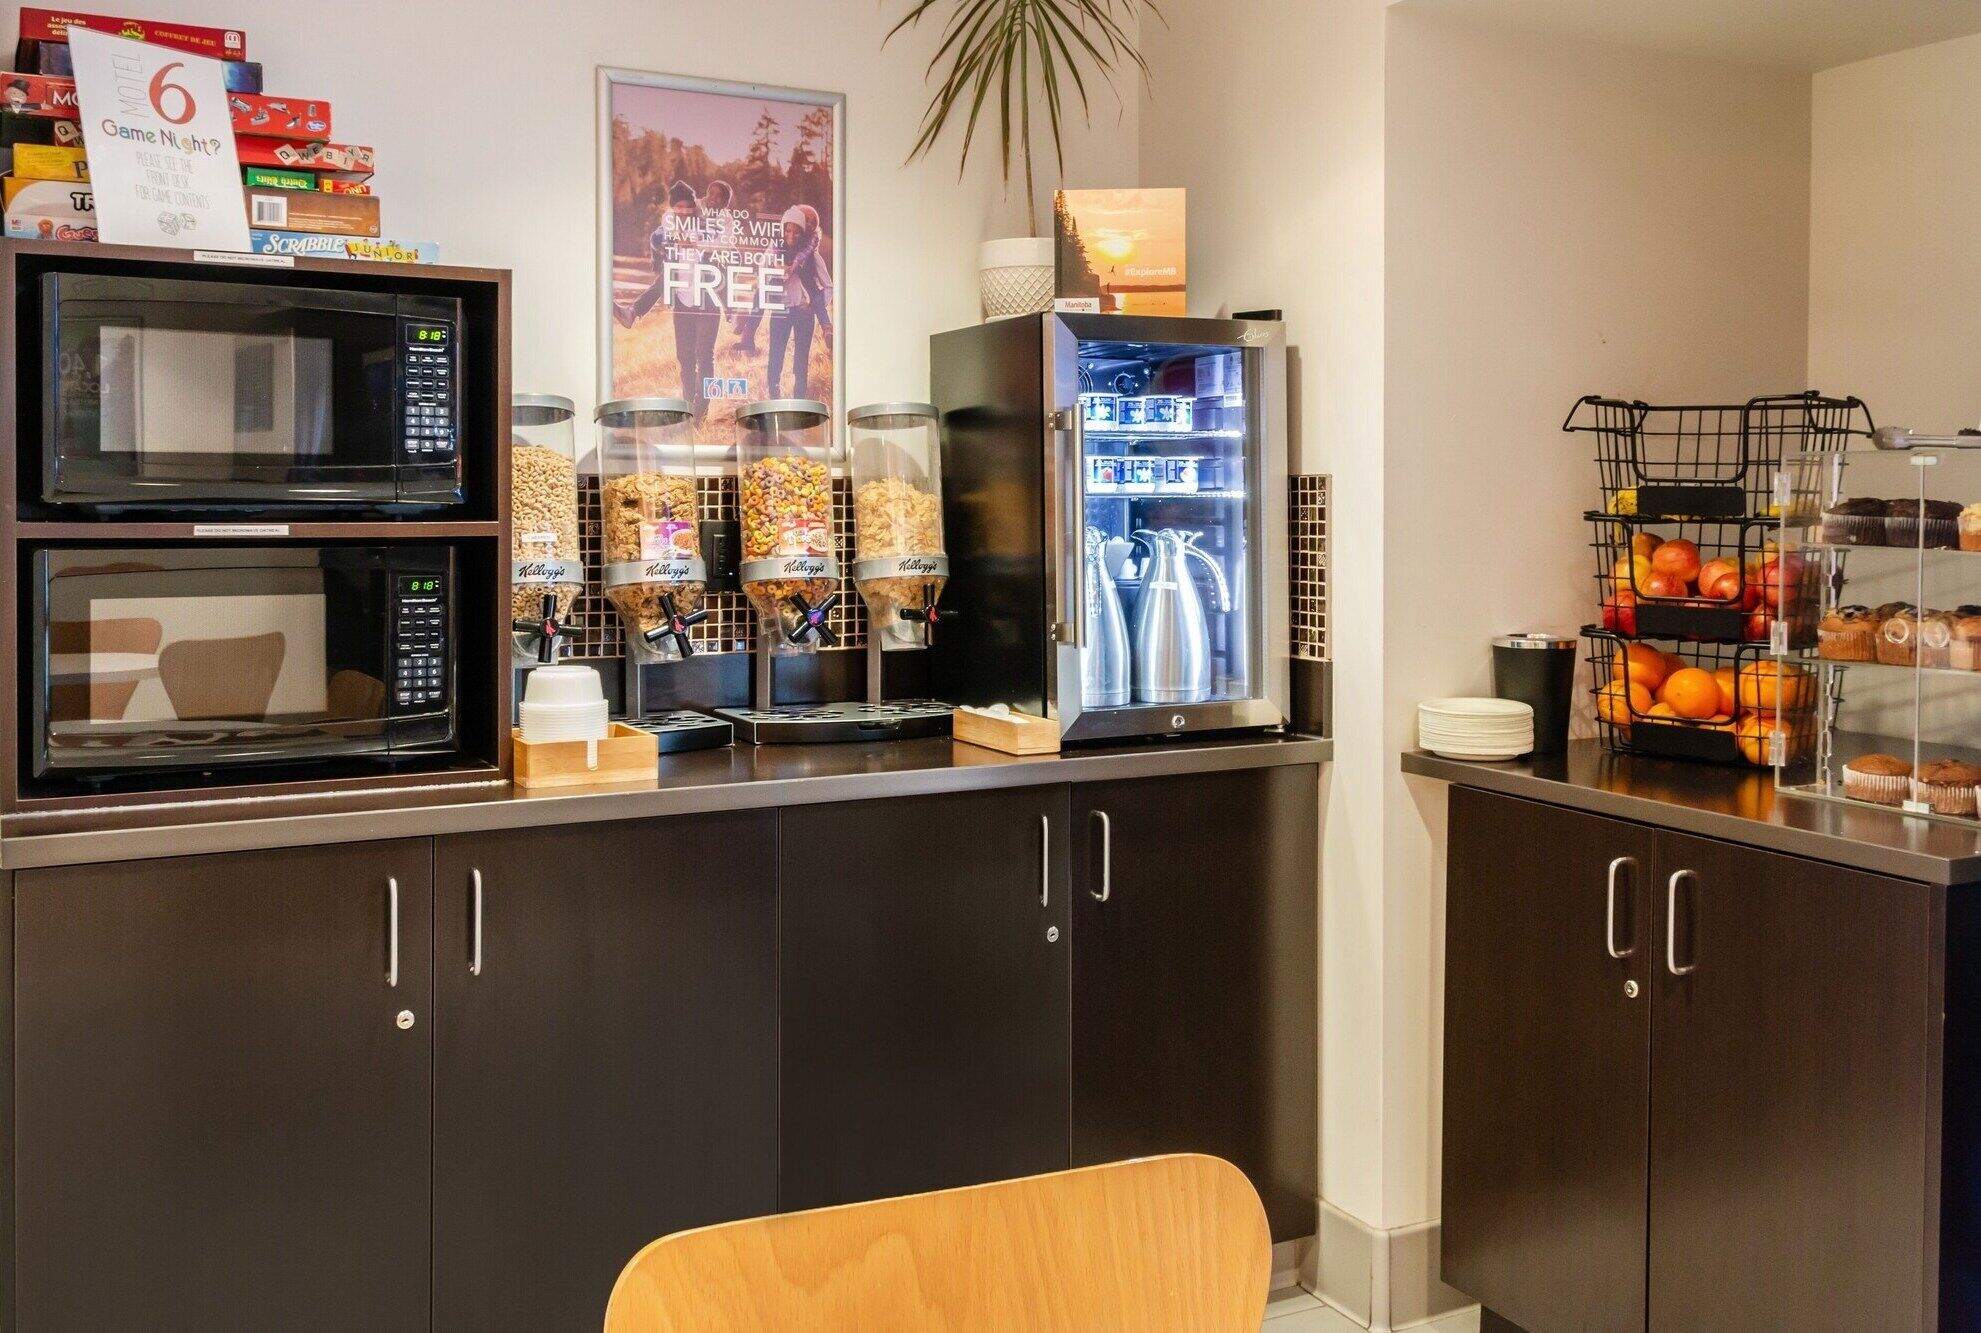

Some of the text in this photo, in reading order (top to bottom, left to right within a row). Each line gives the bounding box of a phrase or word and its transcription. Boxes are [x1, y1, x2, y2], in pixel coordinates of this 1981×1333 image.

[61, 17, 73, 25] jeu
[154, 30, 190, 42] COFFRET
[190, 35, 201, 44] DE
[201, 36, 217, 47] JEU
[111, 53, 151, 118] MOTEL
[148, 62, 197, 125] 6
[101, 119, 221, 156] Game Night?
[135, 151, 163, 169] PLEASE
[145, 168, 169, 187] FRONT
[135, 184, 149, 200] FOR
[151, 186, 173, 204] GAME
[701, 208, 750, 220] WHAT DO
[664, 215, 785, 238] SMILES & WIFI
[262, 233, 346, 256] SCRABBLE
[664, 232, 785, 248] HAVE IN COMMON?
[352, 243, 416, 261] JUNIOR
[665, 246, 785, 267] THEY ARE BOTH
[1123, 266, 1177, 278] #ExploreMB
[663, 262, 786, 311] FREE
[1064, 300, 1093, 309] Manitoba
[518, 563, 566, 580] Kellogg's
[645, 563, 690, 579] Kellogg's
[783, 559, 826, 575] Kellogg's
[898, 558, 939, 574] Kellogg's
